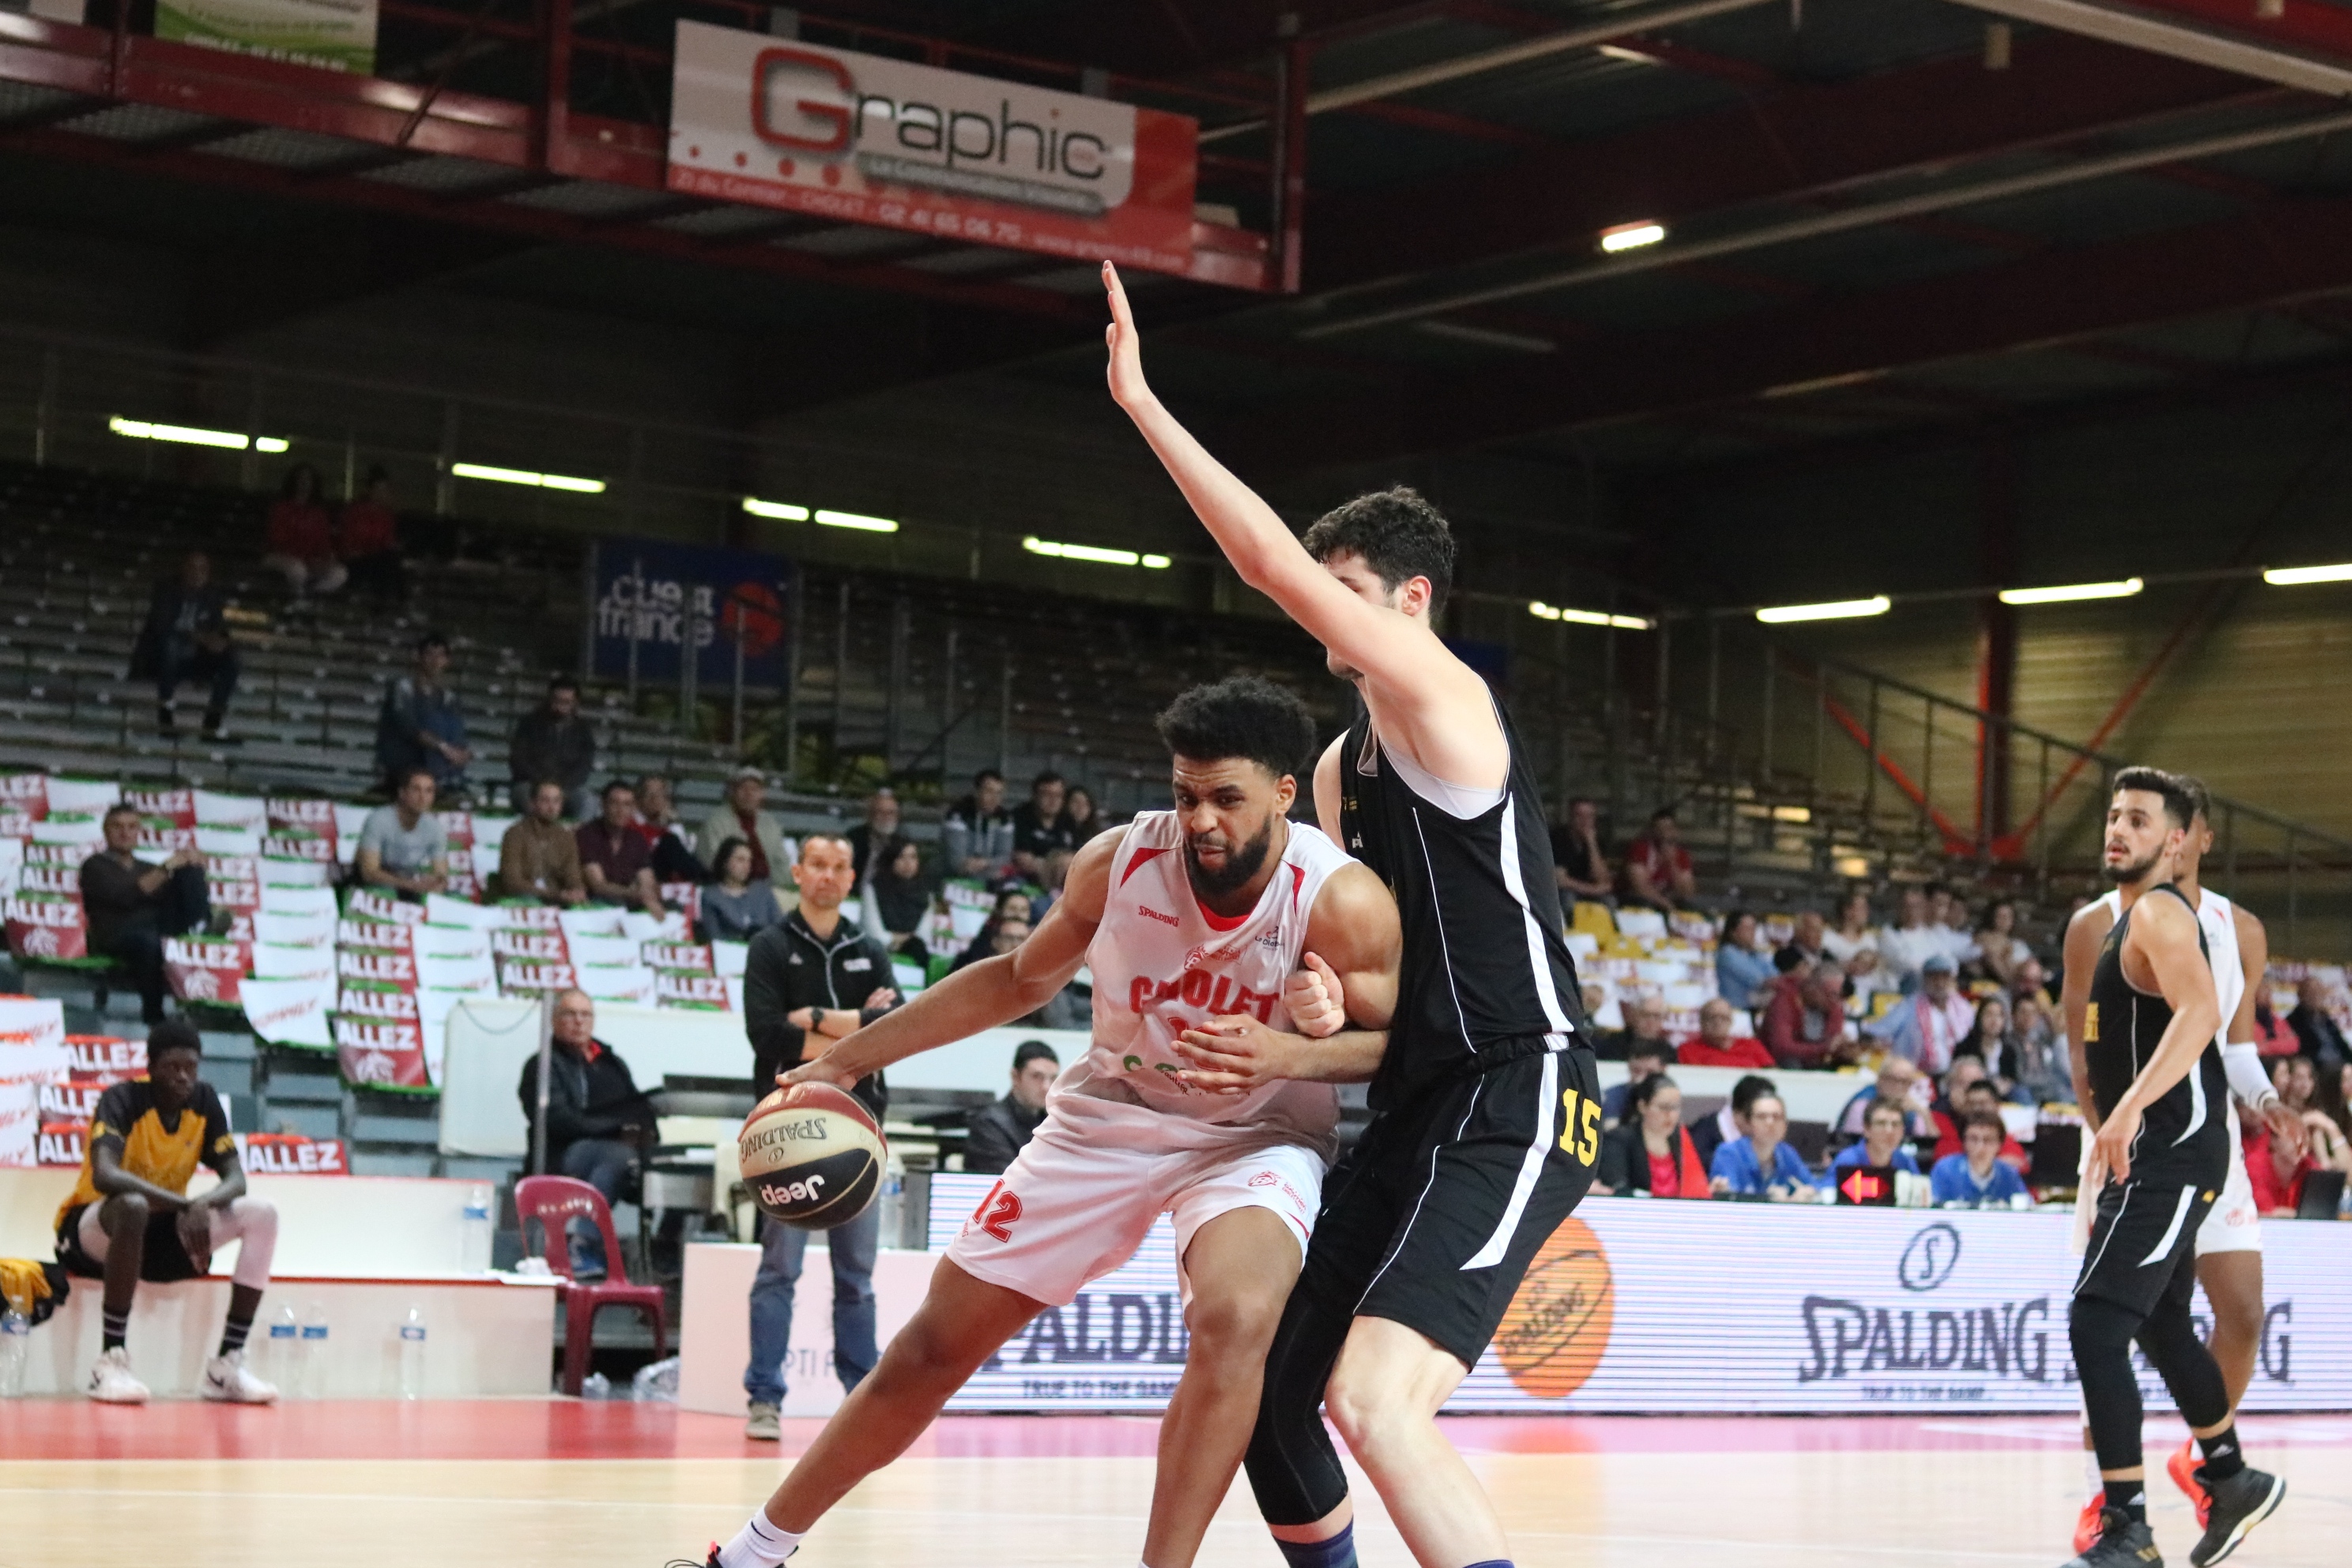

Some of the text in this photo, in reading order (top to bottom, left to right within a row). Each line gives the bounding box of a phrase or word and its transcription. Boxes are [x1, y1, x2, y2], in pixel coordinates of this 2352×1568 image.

[752, 47, 1105, 179] Graphic
[136, 828, 193, 850] LLEZ
[263, 837, 330, 860] ALLEZ
[22, 867, 77, 892] ALLE
[209, 881, 256, 906] LEZ
[5, 898, 80, 928] ALLEZ
[351, 888, 425, 925] ALLEZ
[1138, 905, 1179, 927] SPALDING
[337, 918, 409, 948] ALLEZ
[492, 931, 563, 959] ALLEZ
[164, 937, 241, 969] ALLEZ
[338, 952, 413, 980] ALLEZ
[643, 944, 708, 970] ALLEZ
[503, 963, 572, 989] ALLEZ
[657, 974, 726, 1001] ALLEZ
[341, 989, 418, 1019] ALLEZ
[337, 1020, 418, 1051] ALLEZ
[40, 1085, 103, 1116] ALLE
[741, 1117, 827, 1164] SPALDING
[1559, 1088, 1601, 1167] 15
[39, 1133, 85, 1163] ALL
[248, 1143, 342, 1174] ALLEZ
[761, 1174, 826, 1207] Jeep
[972, 1178, 1023, 1244] 12
[1798, 1295, 2050, 1384] SPALDING
[1023, 1380, 1178, 1399] TRUE TO THE GAM
